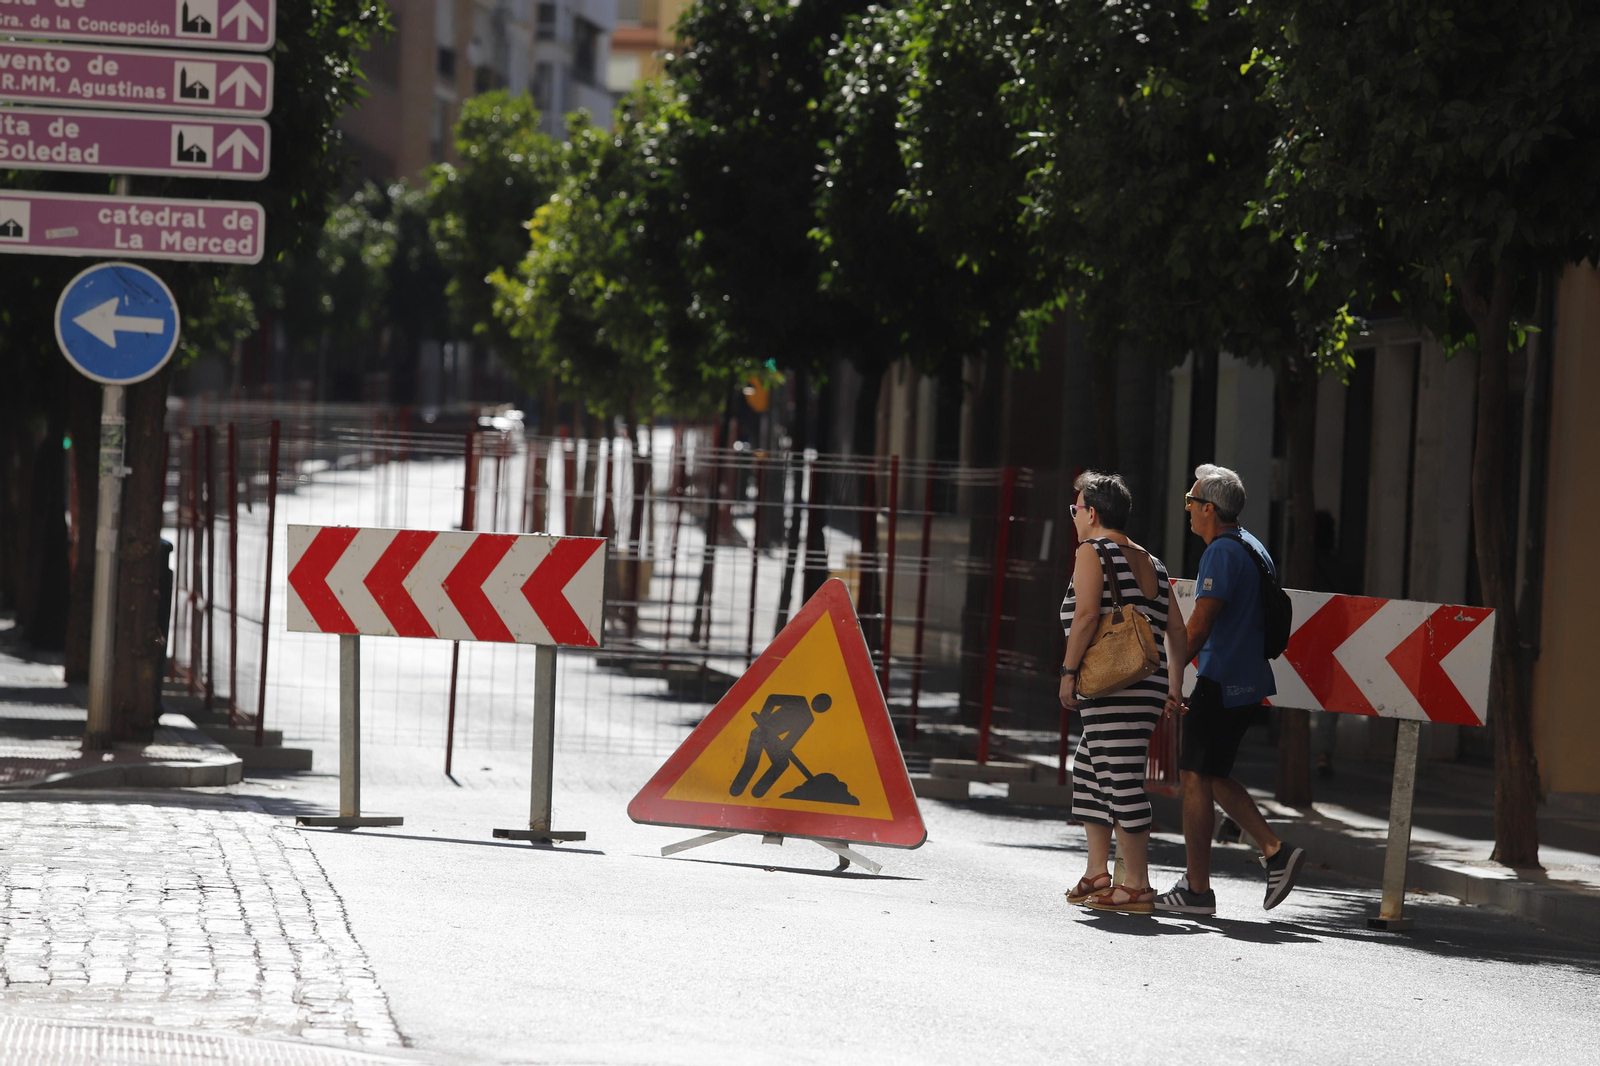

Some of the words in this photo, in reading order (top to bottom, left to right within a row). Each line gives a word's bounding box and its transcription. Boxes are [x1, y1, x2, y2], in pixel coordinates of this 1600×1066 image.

[30, 13, 50, 29] de
[56, 14, 71, 30] la
[77, 16, 170, 36] Concepción
[0, 51, 70, 73] vento
[87, 55, 119, 76] de
[2, 73, 61, 93] R.MM.
[68, 78, 166, 100] Agustinas
[48, 117, 80, 139] de
[0, 138, 99, 164] Soledad
[98, 205, 206, 229] catedral
[222, 210, 254, 231] de
[115, 228, 143, 250] La
[160, 231, 253, 255] Merced
